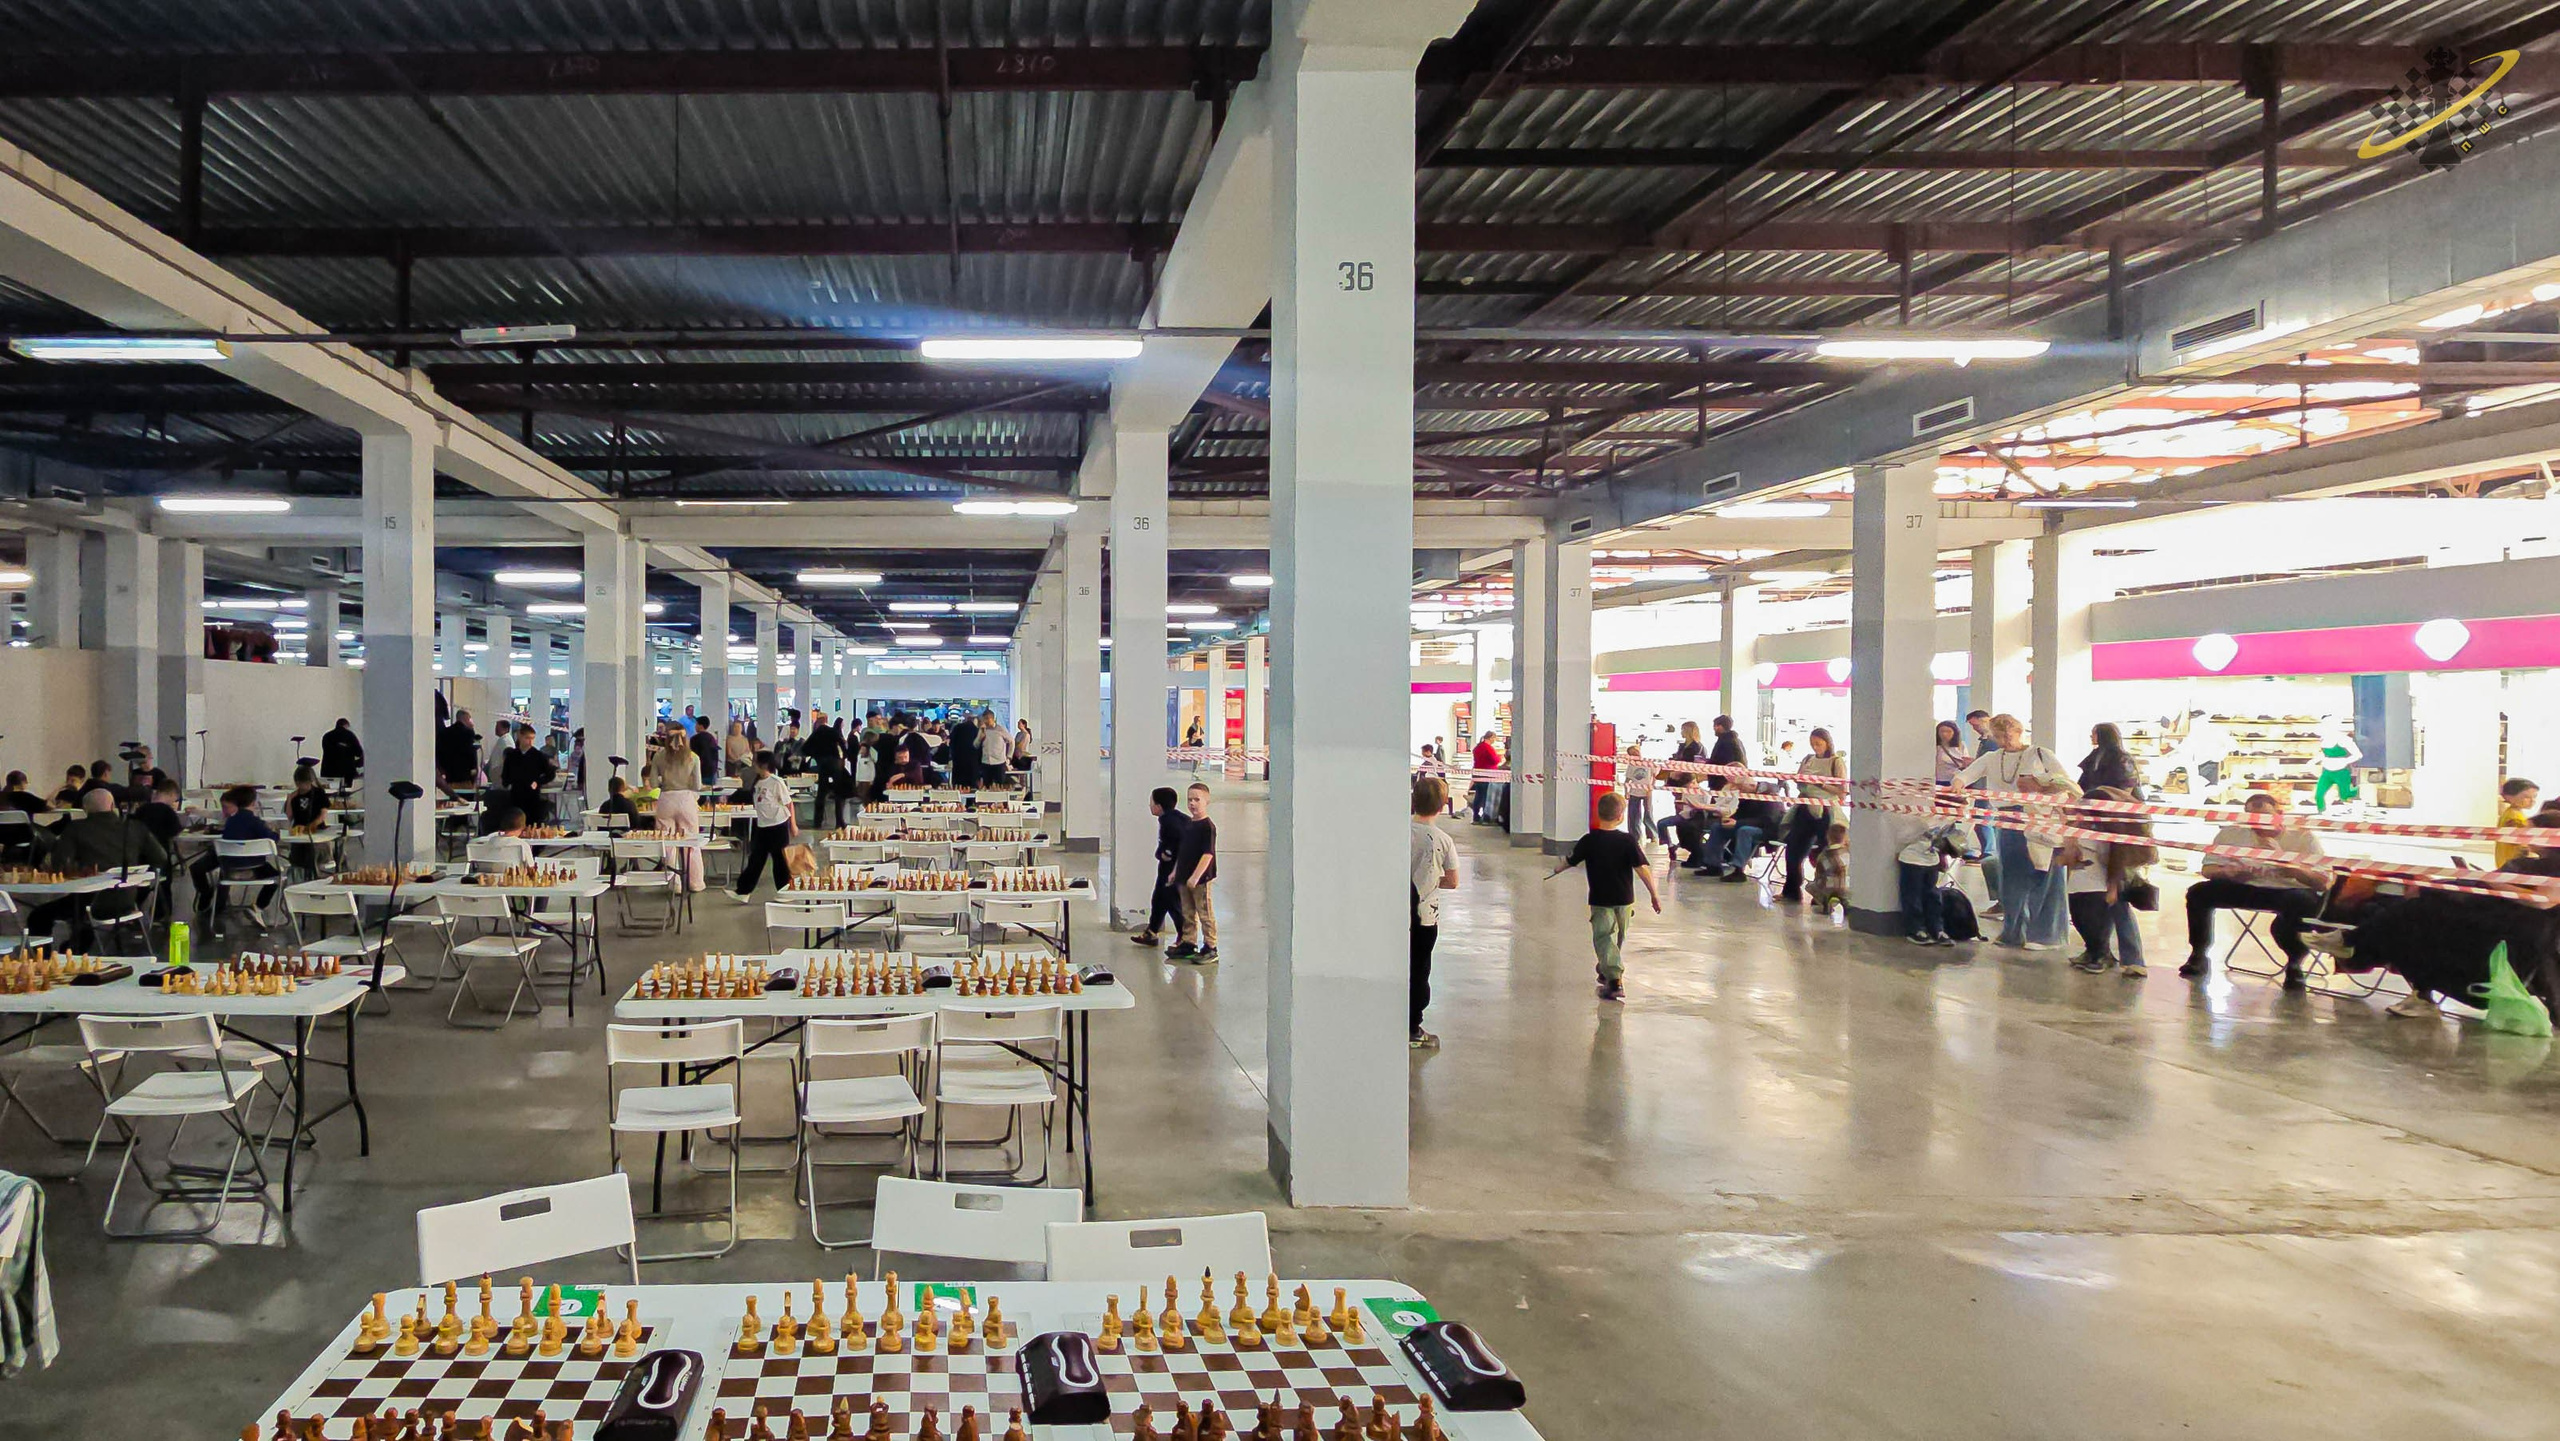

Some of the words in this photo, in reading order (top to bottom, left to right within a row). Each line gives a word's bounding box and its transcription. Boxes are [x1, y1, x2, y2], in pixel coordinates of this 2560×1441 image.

[1338, 261, 1374, 291] 36
[1133, 517, 1150, 530] 36
[1906, 514, 1923, 528] 37
